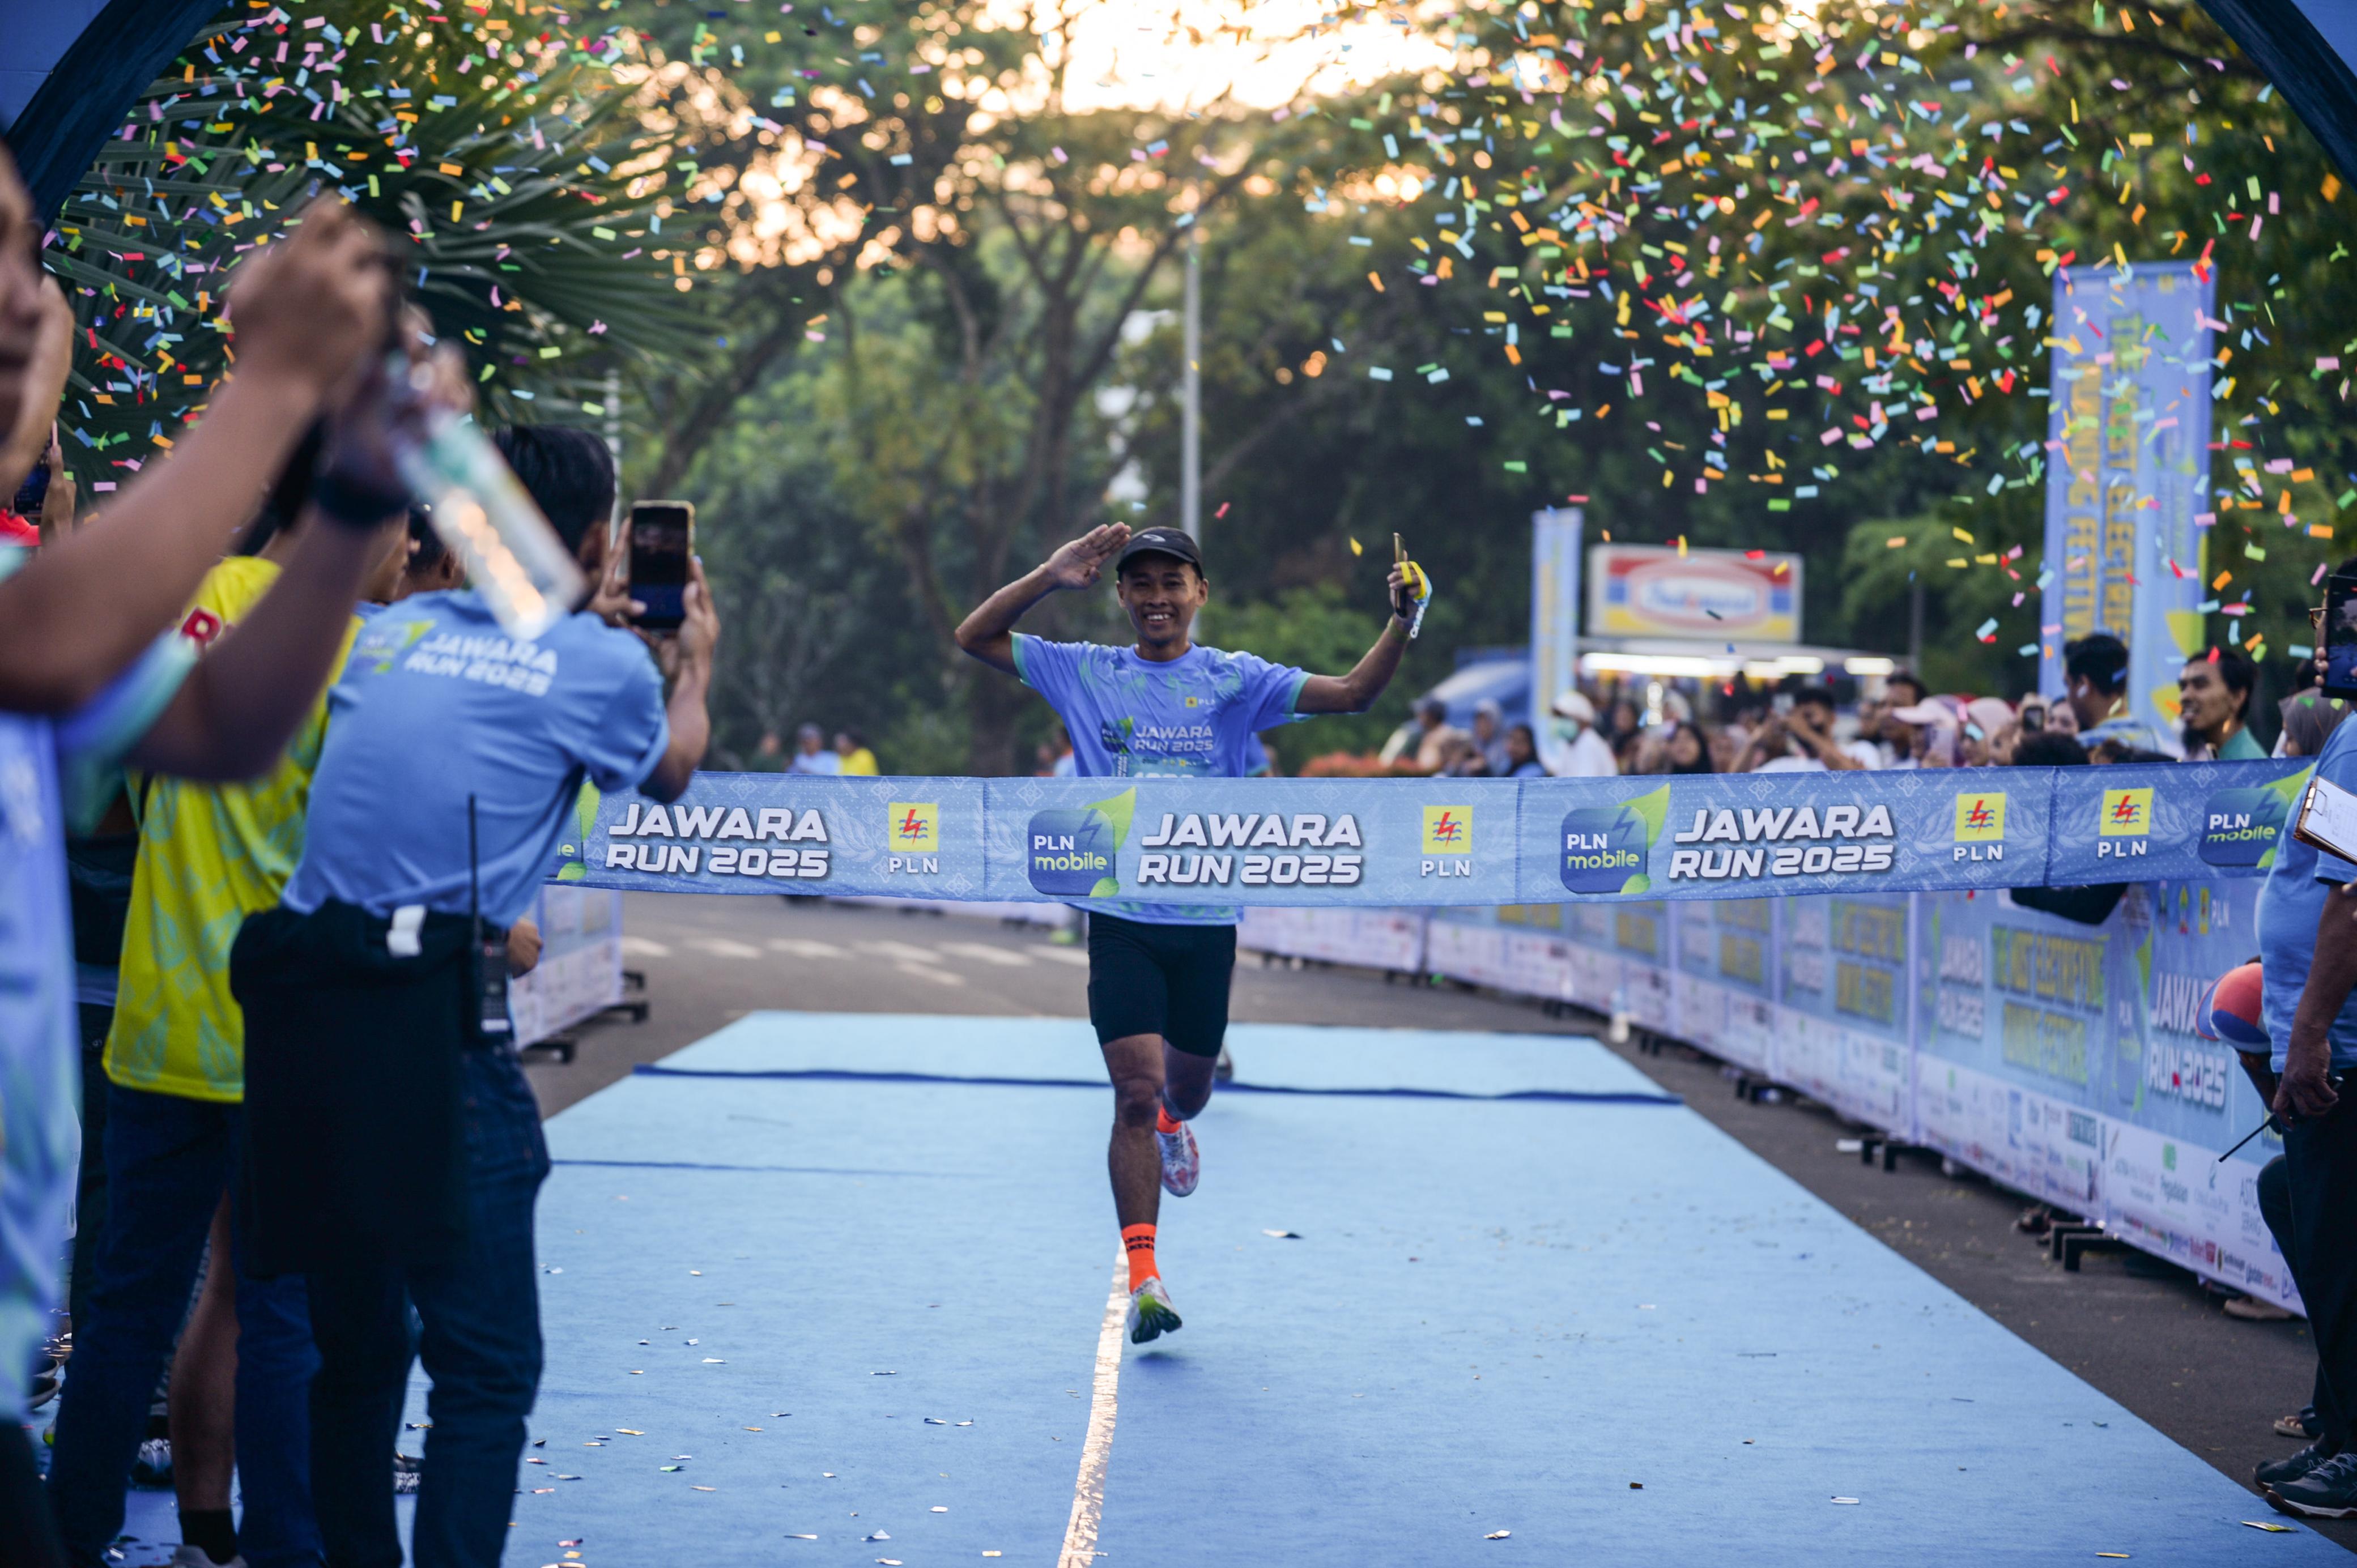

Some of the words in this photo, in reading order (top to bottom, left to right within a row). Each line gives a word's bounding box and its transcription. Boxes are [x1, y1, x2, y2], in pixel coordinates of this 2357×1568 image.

[2104, 484, 2136, 649] ELECTRIF
[2064, 515, 2098, 643] FESTIV
[1135, 726, 1214, 739] JAWARA
[1134, 740, 1169, 752] RUN
[1172, 740, 1214, 752] 2025
[609, 803, 828, 842] JAWARA
[1141, 813, 1362, 847] JAWARA
[1674, 804, 1895, 843] JAWARA
[2209, 813, 2251, 830] PLN
[1034, 834, 1075, 850] PLN
[1567, 833, 1608, 850] PLN
[2206, 825, 2276, 843] mobile
[1567, 849, 1640, 870] mobile
[1953, 844, 2003, 862] PLN
[2097, 840, 2148, 858] PLN
[605, 843, 700, 874] RUN
[707, 846, 829, 878] 2025
[888, 857, 938, 874] PLN
[1035, 851, 1108, 871] mobile
[1137, 854, 1233, 884] RUN
[1240, 854, 1362, 884] 2025
[1420, 859, 1471, 877] PLN
[1669, 849, 1765, 879] RUN
[1771, 844, 1895, 874] 2025
[2211, 898, 2230, 928] PLN
[2151, 971, 2212, 1037] JAWA
[2148, 1041, 2181, 1092] RUN
[2182, 1051, 2227, 1107] 2025
